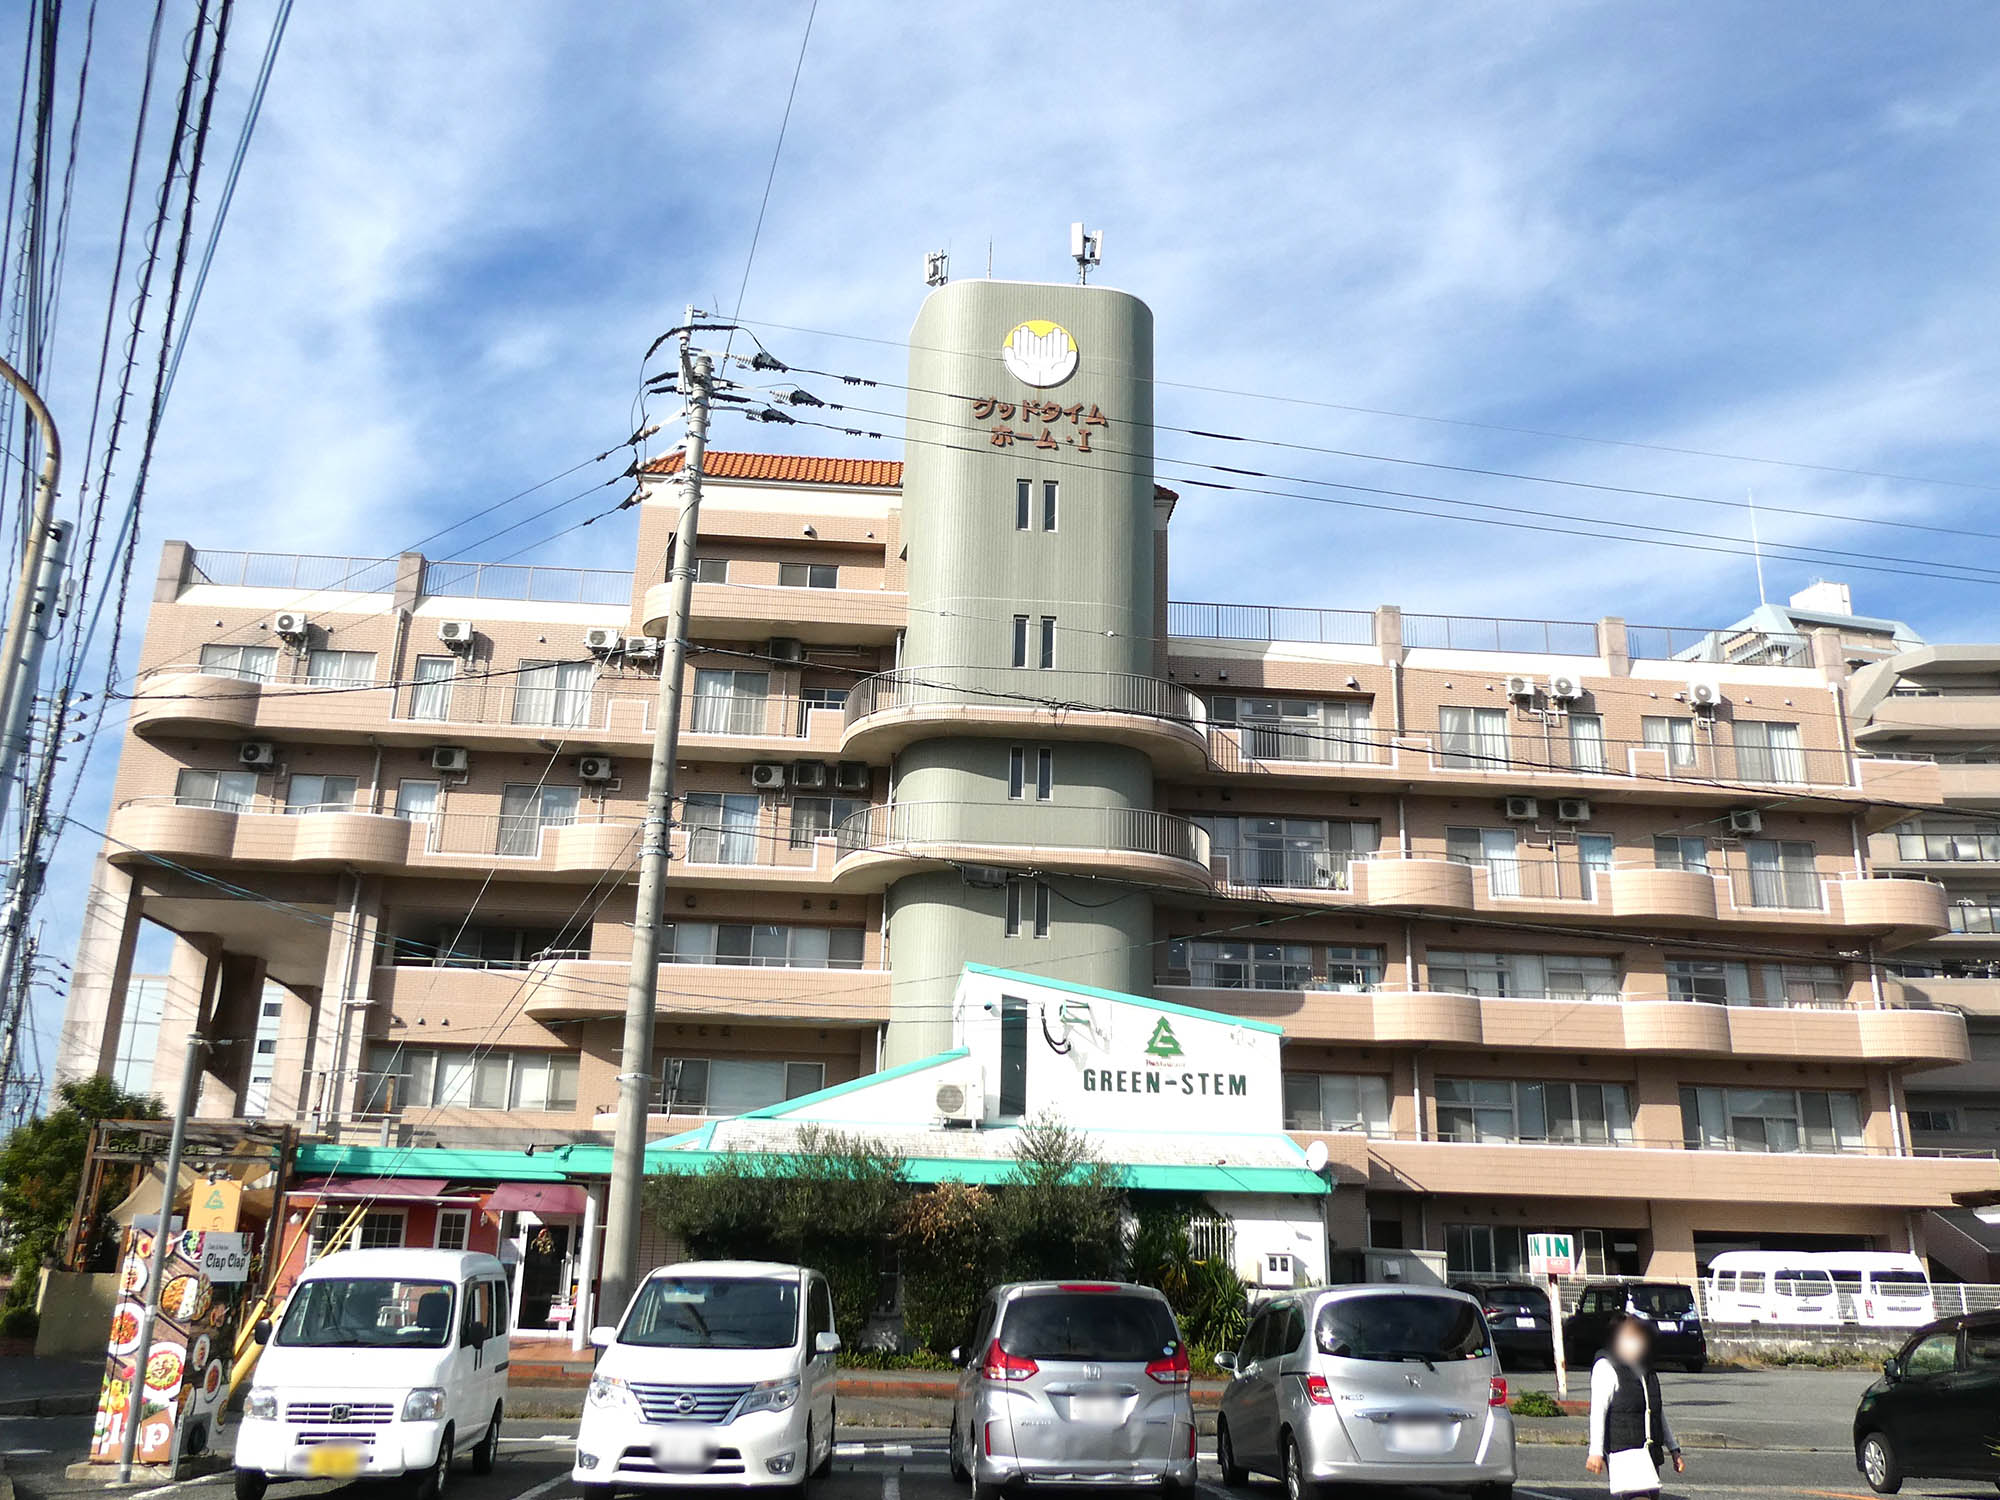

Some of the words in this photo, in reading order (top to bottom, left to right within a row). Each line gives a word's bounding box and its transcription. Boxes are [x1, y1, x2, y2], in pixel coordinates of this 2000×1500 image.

[973, 395, 1107, 426] グッドタイム
[1083, 1068, 1247, 1096] GREEN-STEM
[1545, 1236, 1570, 1258] IN
[206, 1253, 226, 1270] Clap
[227, 1253, 246, 1270] Clap
